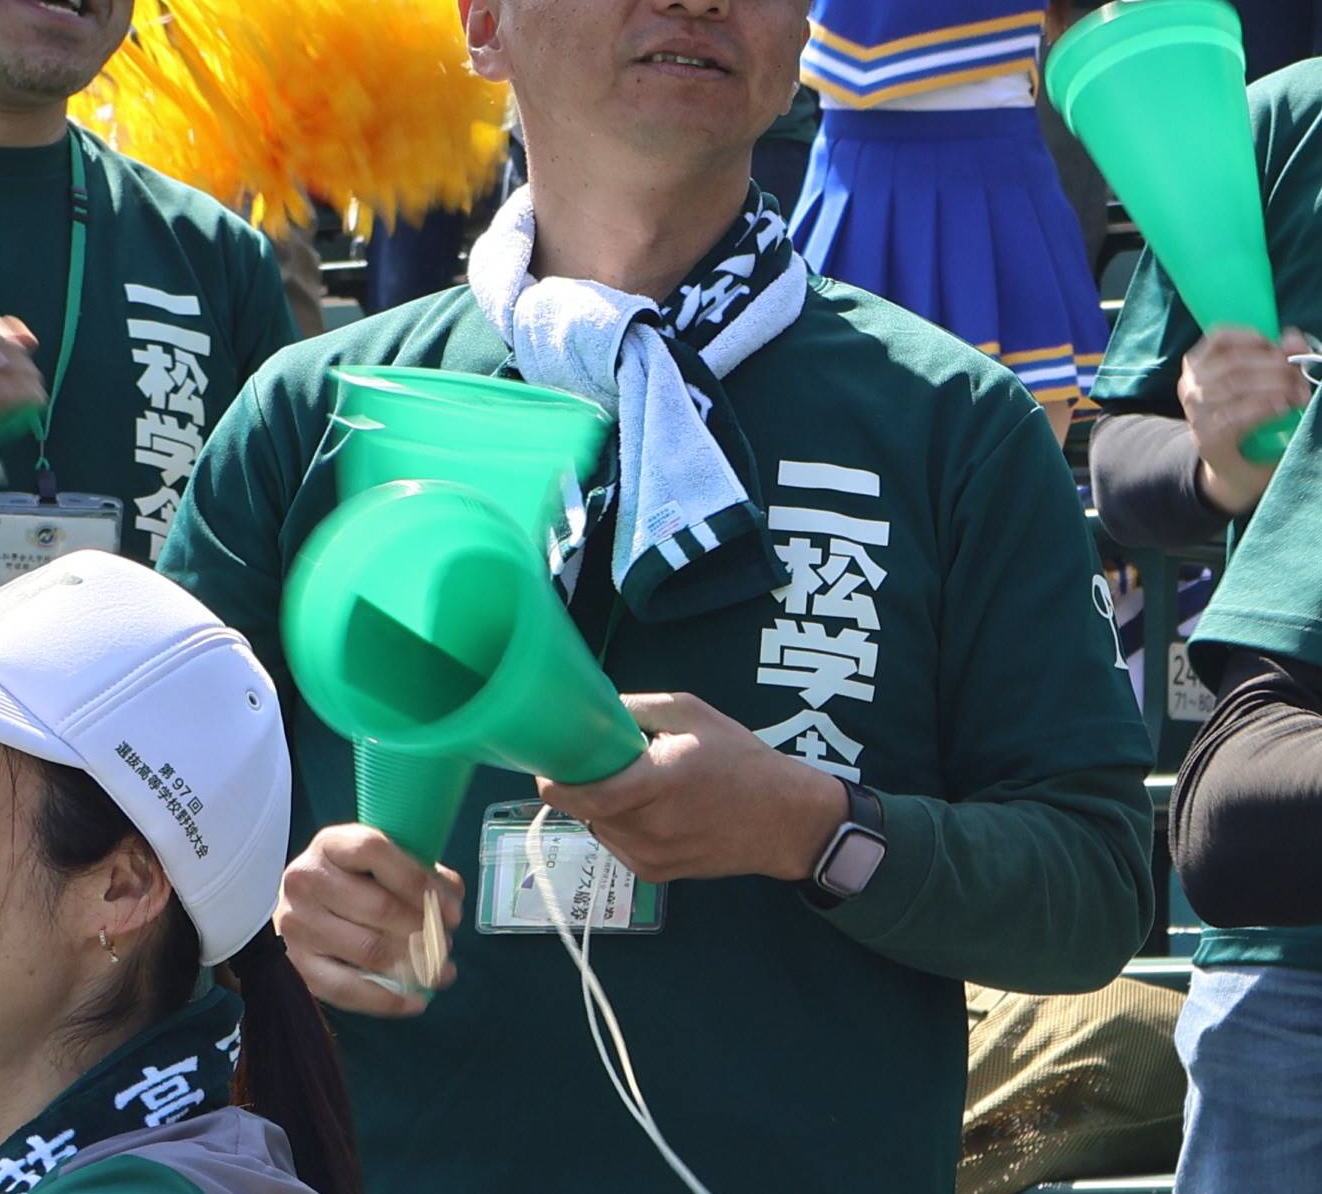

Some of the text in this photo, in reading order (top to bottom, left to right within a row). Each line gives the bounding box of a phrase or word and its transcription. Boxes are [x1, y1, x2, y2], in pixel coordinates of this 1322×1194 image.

[113, 739, 210, 860] 選抜高等学校野球大会
